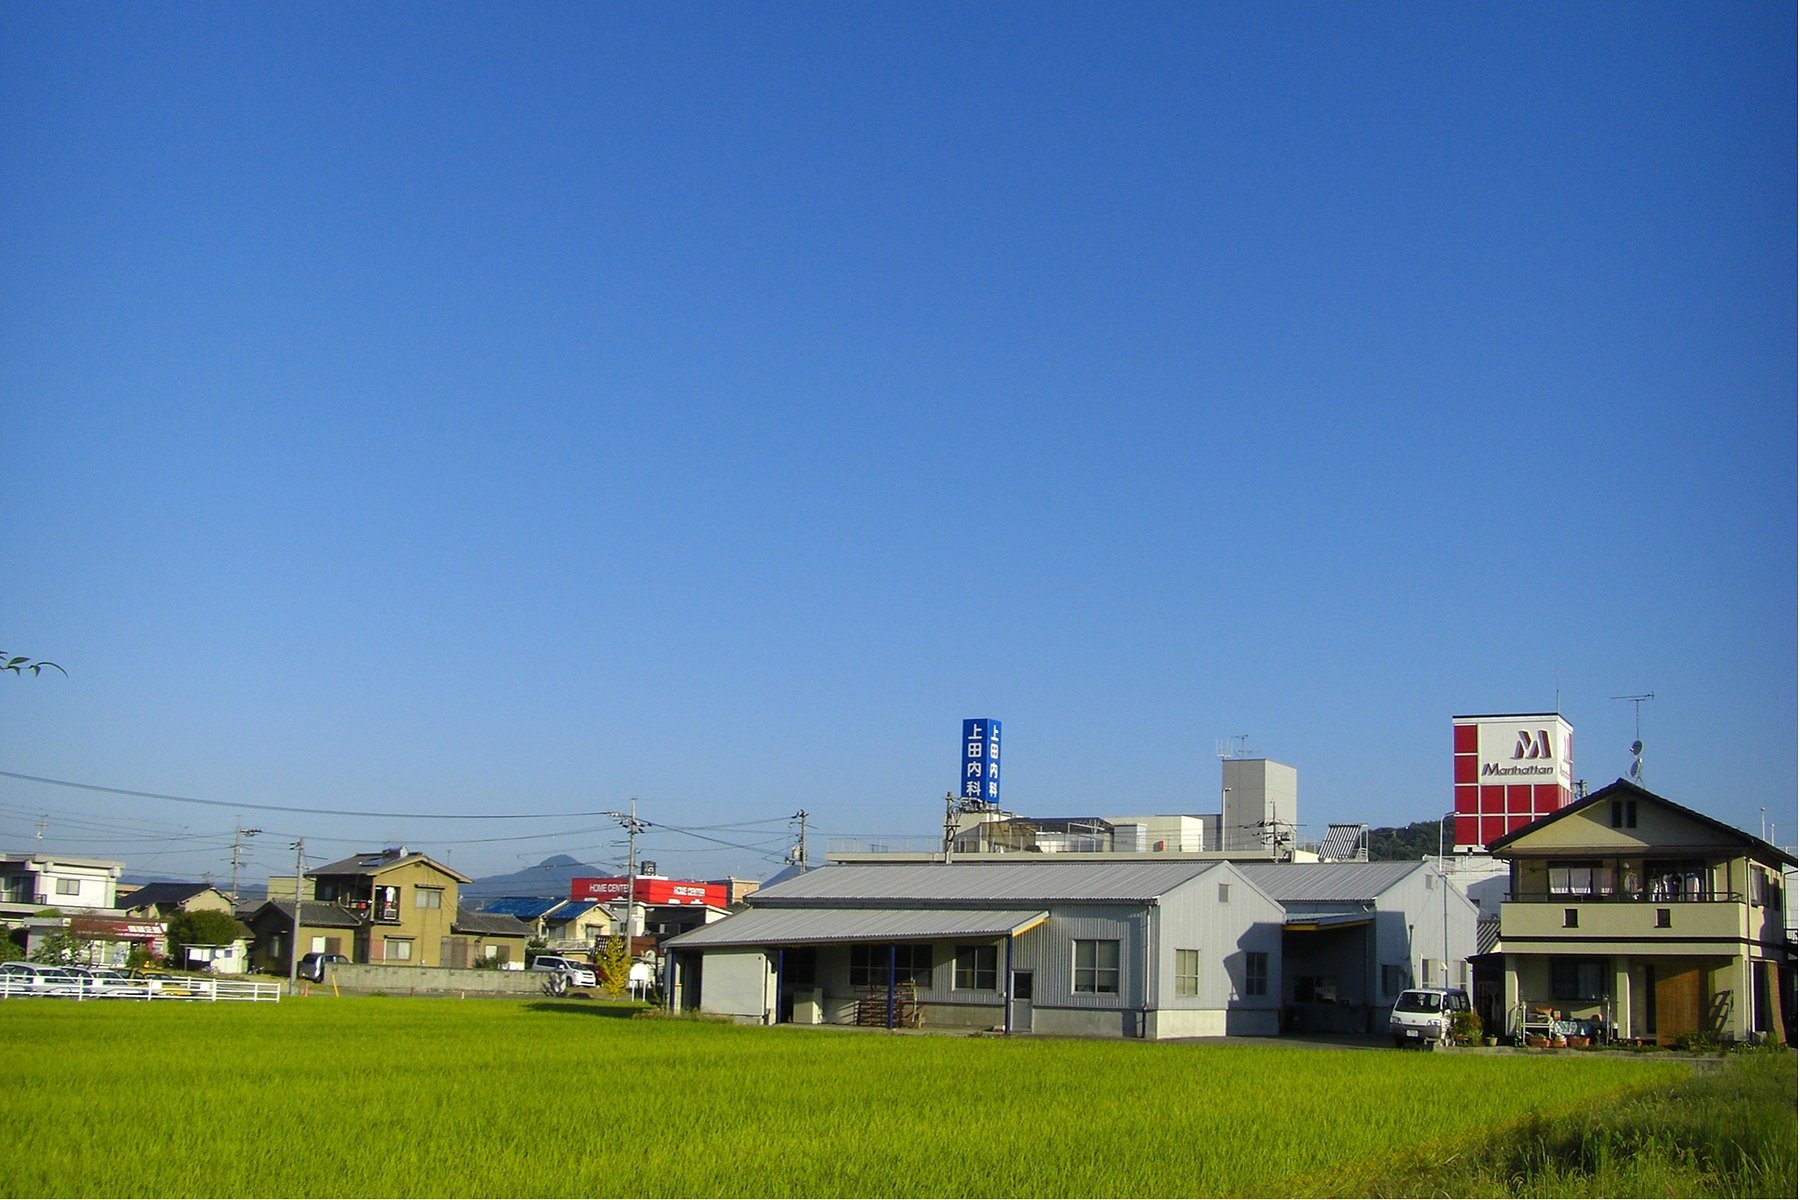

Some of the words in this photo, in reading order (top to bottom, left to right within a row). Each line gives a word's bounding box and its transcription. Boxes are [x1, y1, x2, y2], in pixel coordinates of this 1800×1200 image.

[966, 723, 982, 796] 上田内科
[1481, 763, 1553, 776] Manhattan
[589, 883, 607, 892] HOME
[608, 883, 632, 893] CENTE
